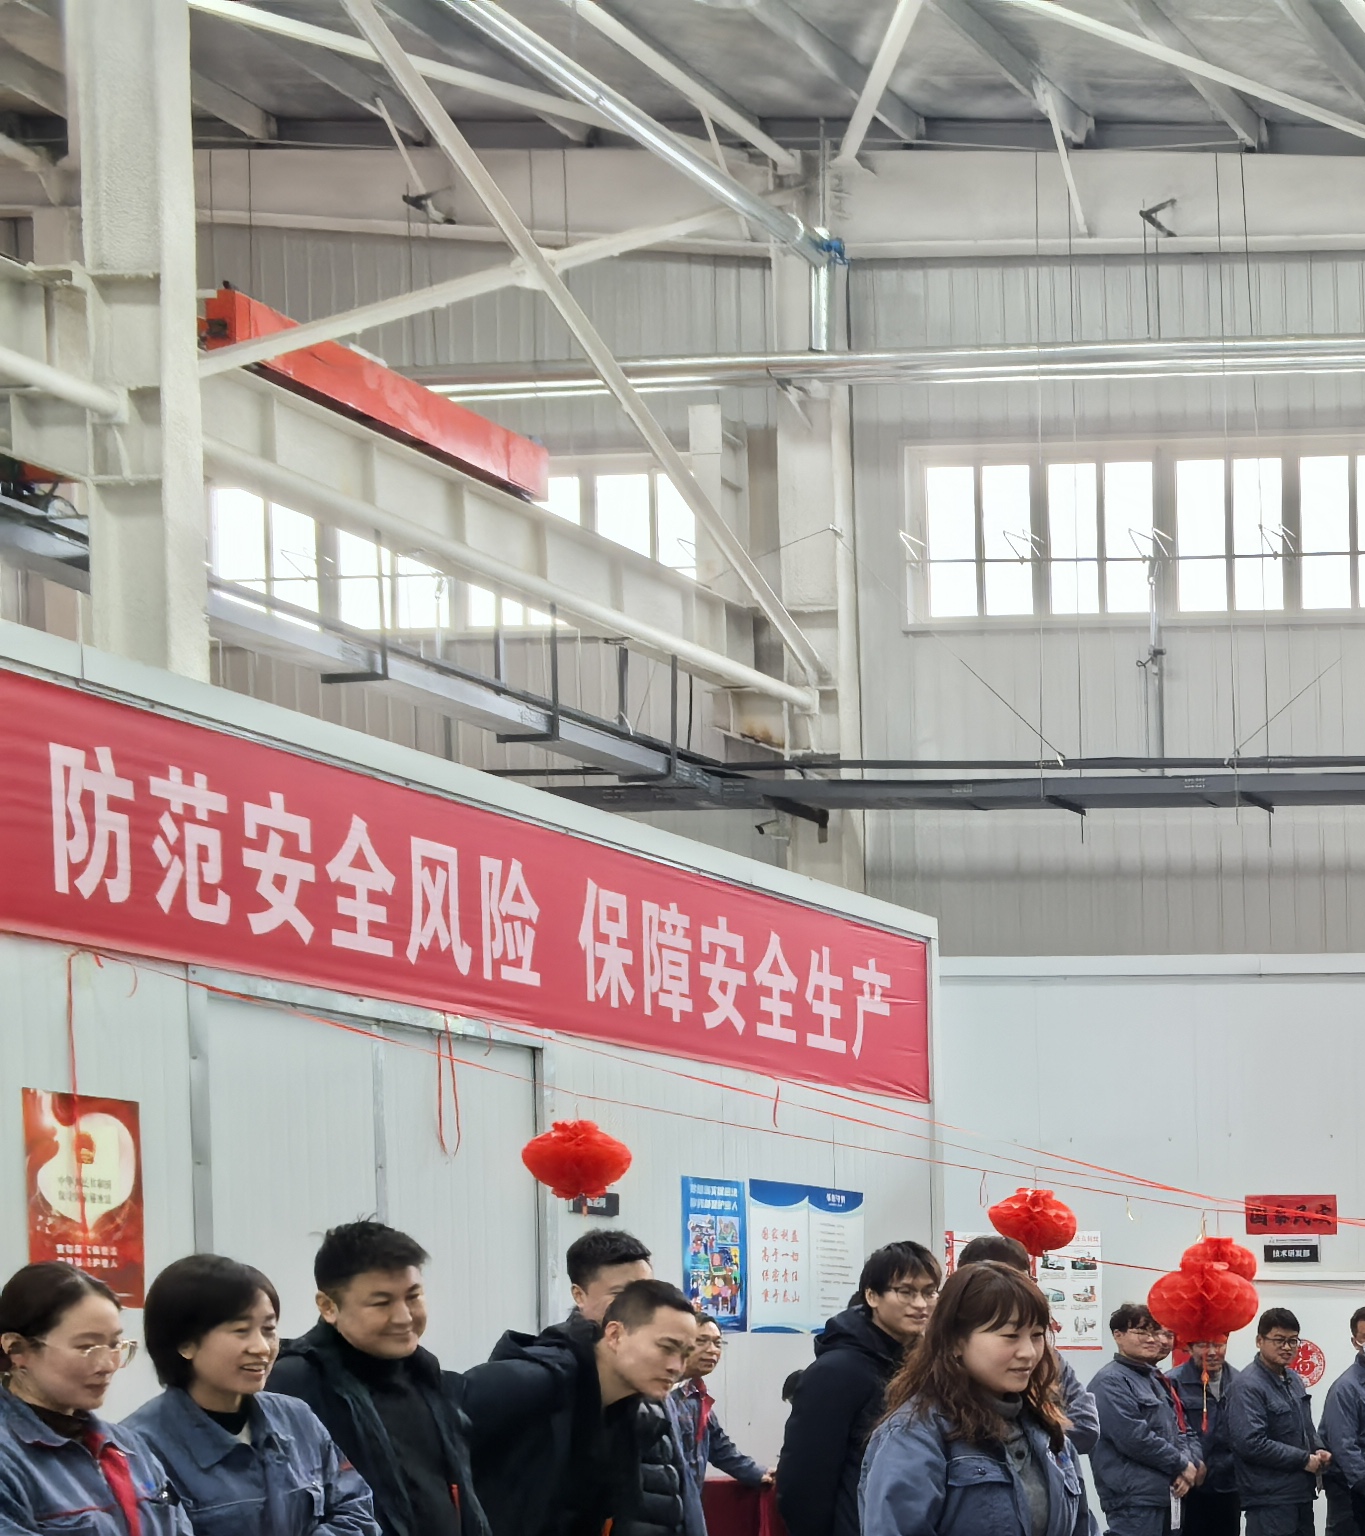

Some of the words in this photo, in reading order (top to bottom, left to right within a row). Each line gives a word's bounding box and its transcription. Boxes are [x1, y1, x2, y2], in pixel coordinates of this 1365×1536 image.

[48, 743, 541, 988] 防范安全风险
[578, 879, 893, 1061] 保障安全生产
[762, 1227, 799, 1243] 国家利益
[762, 1246, 799, 1263] 高于一切
[1272, 1249, 1311, 1258] 技术研发部
[762, 1268, 799, 1282] 保密责任
[761, 1288, 800, 1303] 重于泰山
